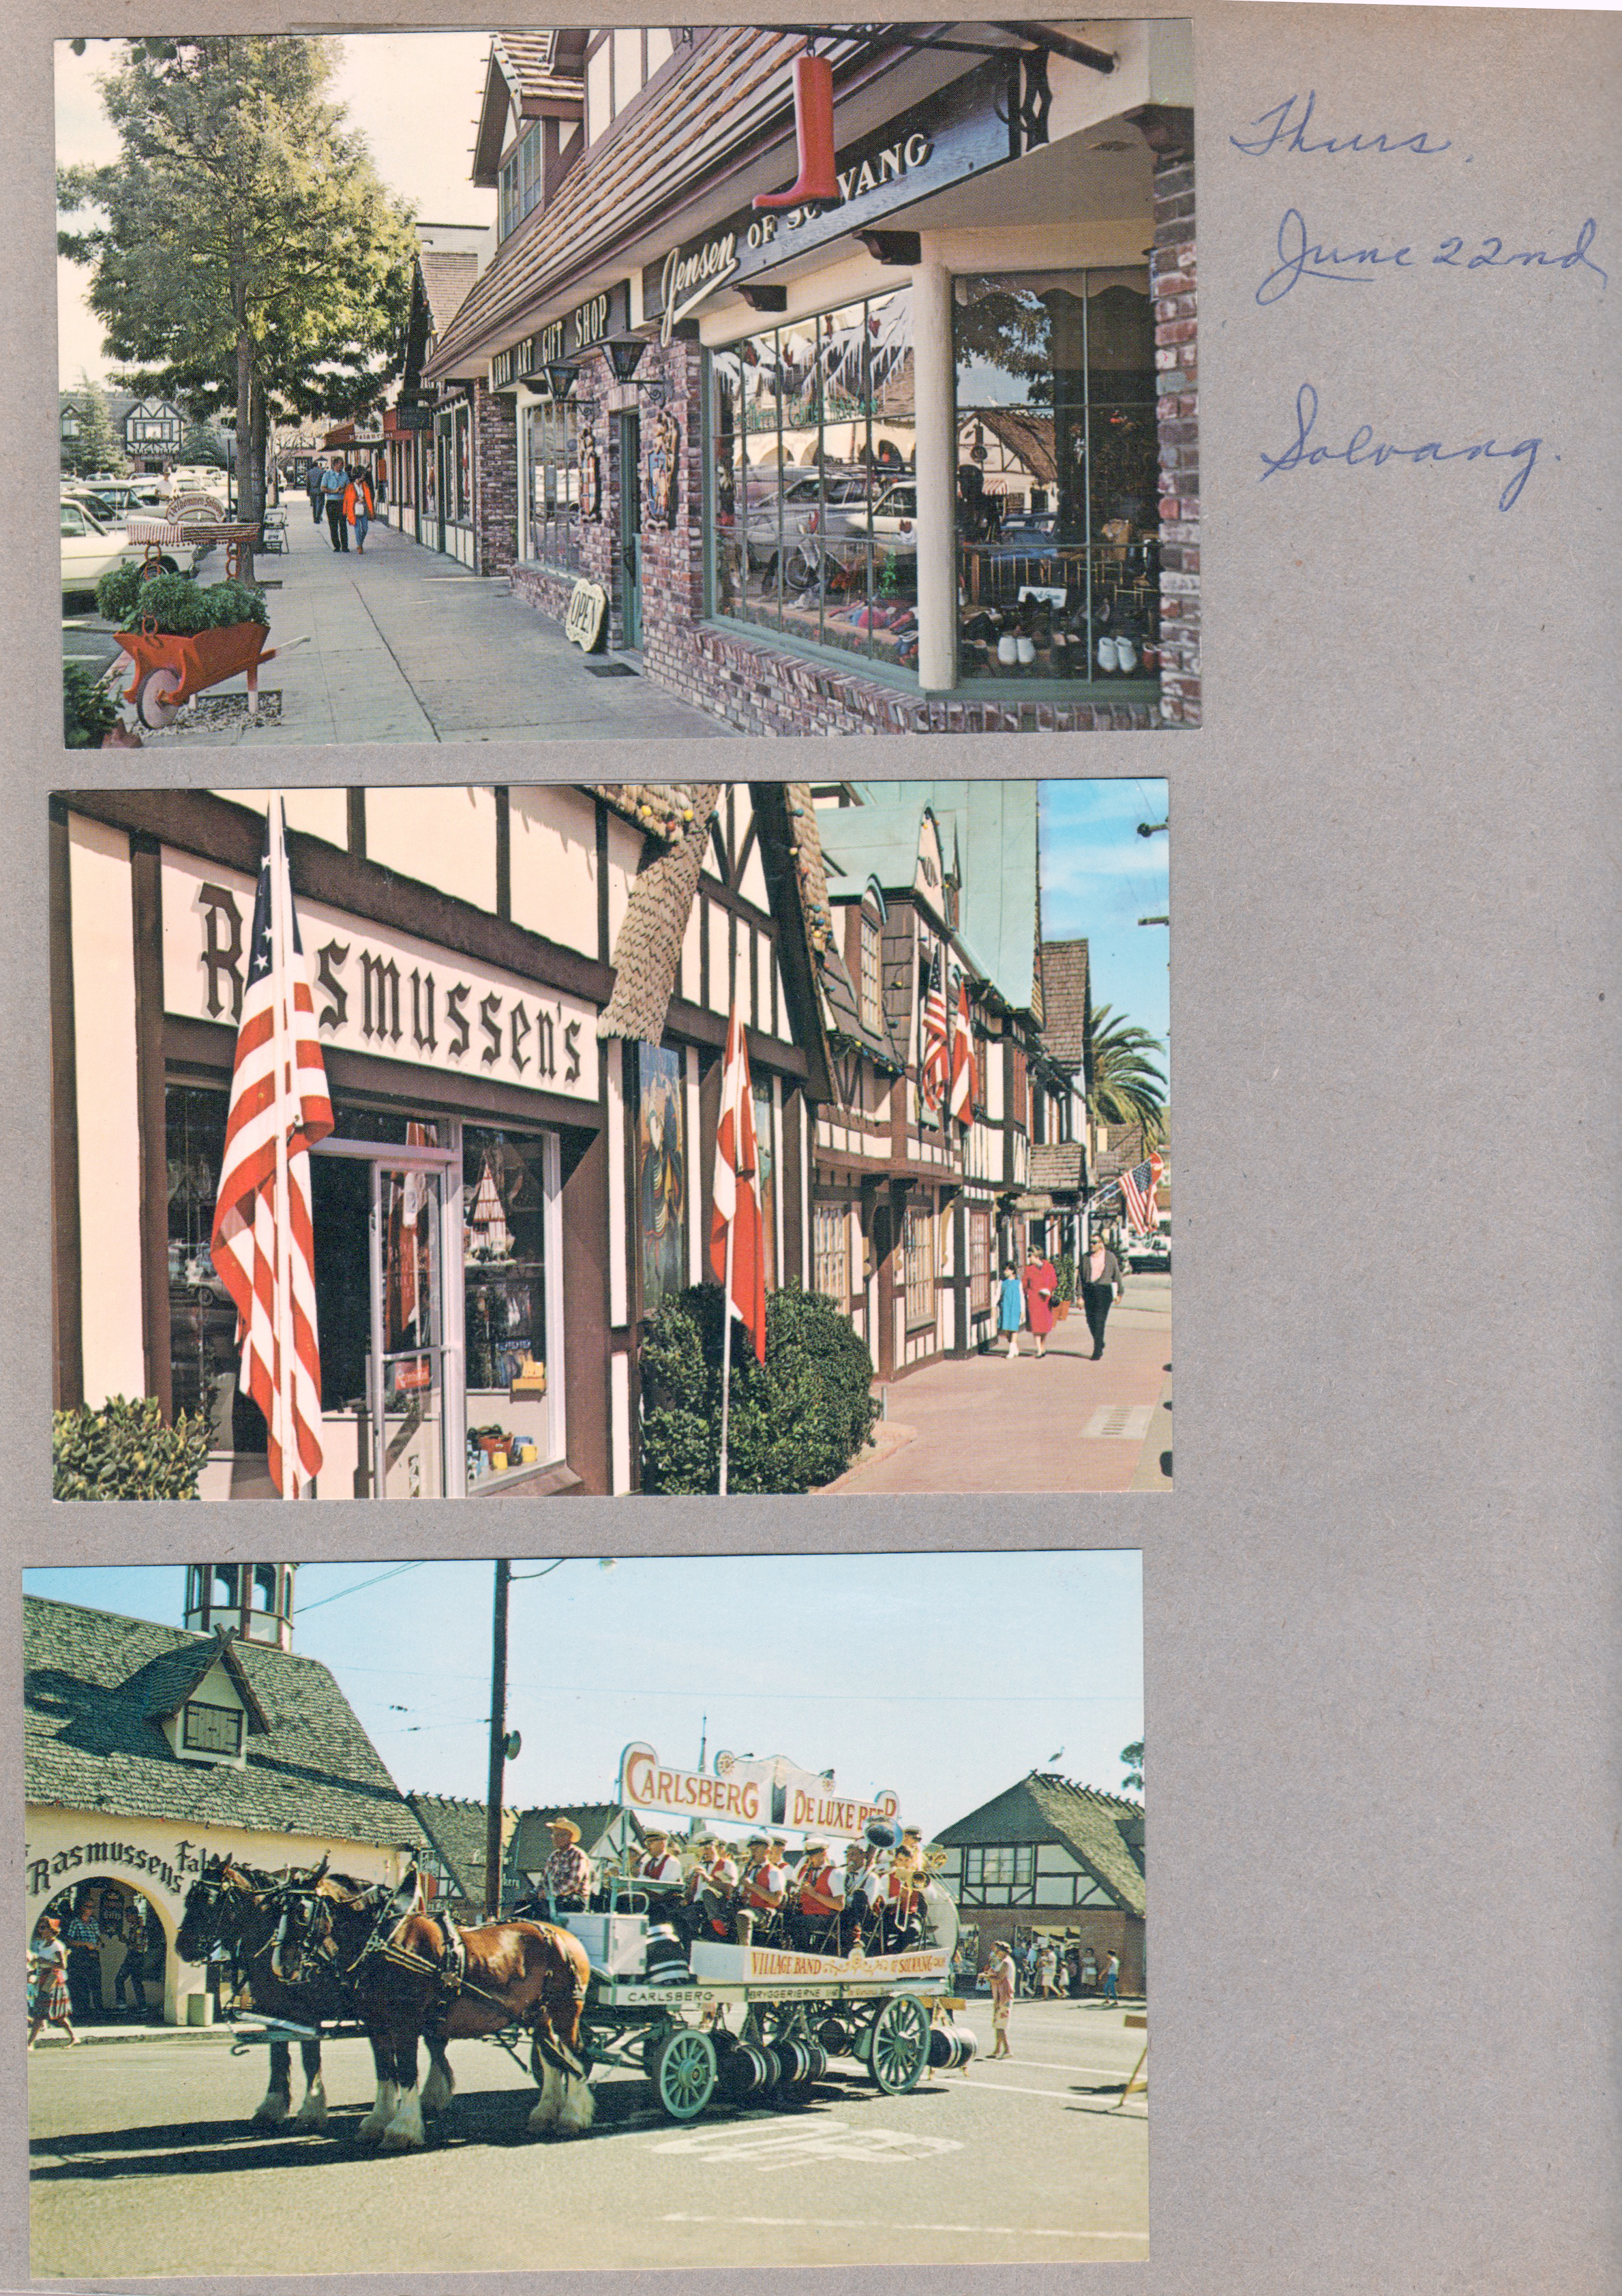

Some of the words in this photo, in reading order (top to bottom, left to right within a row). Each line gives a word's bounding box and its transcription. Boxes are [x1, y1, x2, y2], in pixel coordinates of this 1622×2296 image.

[1229, 89, 1474, 164] Thurs.
[661, 232, 738, 348] Jensen
[747, 215, 777, 249] OF
[787, 133, 929, 230] SVANG
[1255, 208, 1416, 305] June
[1432, 217, 1608, 290] 22nd
[542, 320, 562, 365] GIFT
[575, 294, 607, 348] SHOP
[570, 590, 596, 635] OPEN
[196, 881, 582, 1085] Rsmussen's
[626, 1751, 760, 1820] CARLSBERG
[792, 1789, 814, 1826] DE
[817, 1798, 855, 1830] LUXE
[26, 1841, 184, 1894] Rasmussens
[627, 1991, 715, 2002] CARLSBERG
[751, 1952, 792, 1975] VILLAGE
[794, 1956, 822, 1975] BAND
